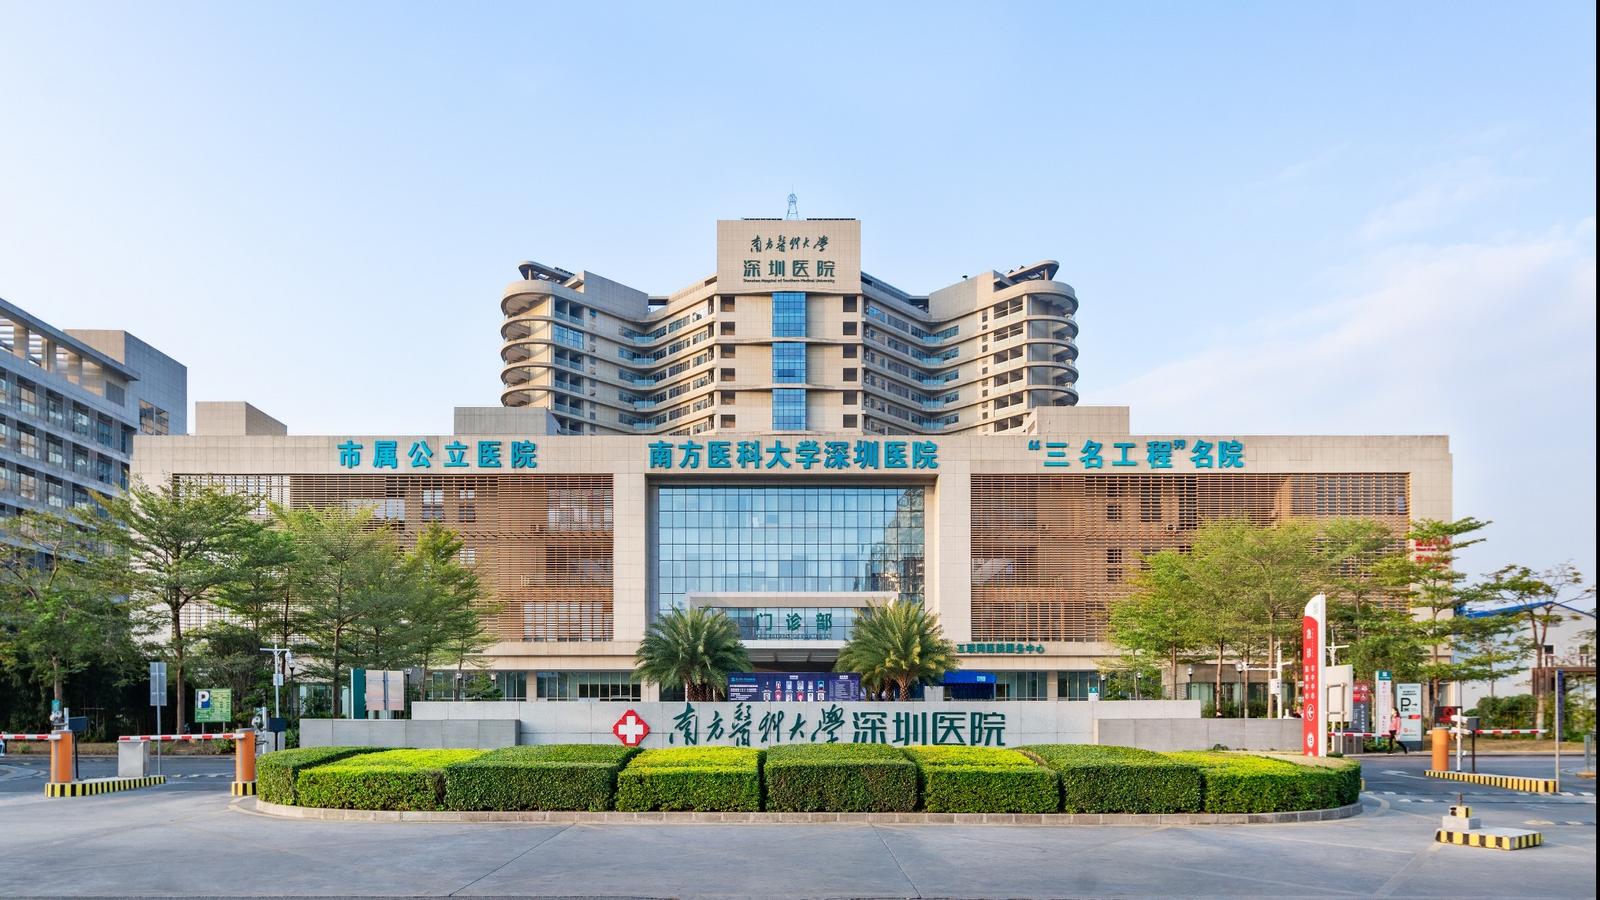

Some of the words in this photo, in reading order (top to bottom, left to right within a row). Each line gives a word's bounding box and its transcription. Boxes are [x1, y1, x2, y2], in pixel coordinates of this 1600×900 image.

[743, 260, 835, 277] 深圳医院
[337, 440, 538, 469] 市属公立医院
[648, 440, 939, 470] 南方医科大学深圳医院
[757, 612, 833, 632] 门诊部
[197, 690, 210, 709] P
[1400, 697, 1412, 712] P
